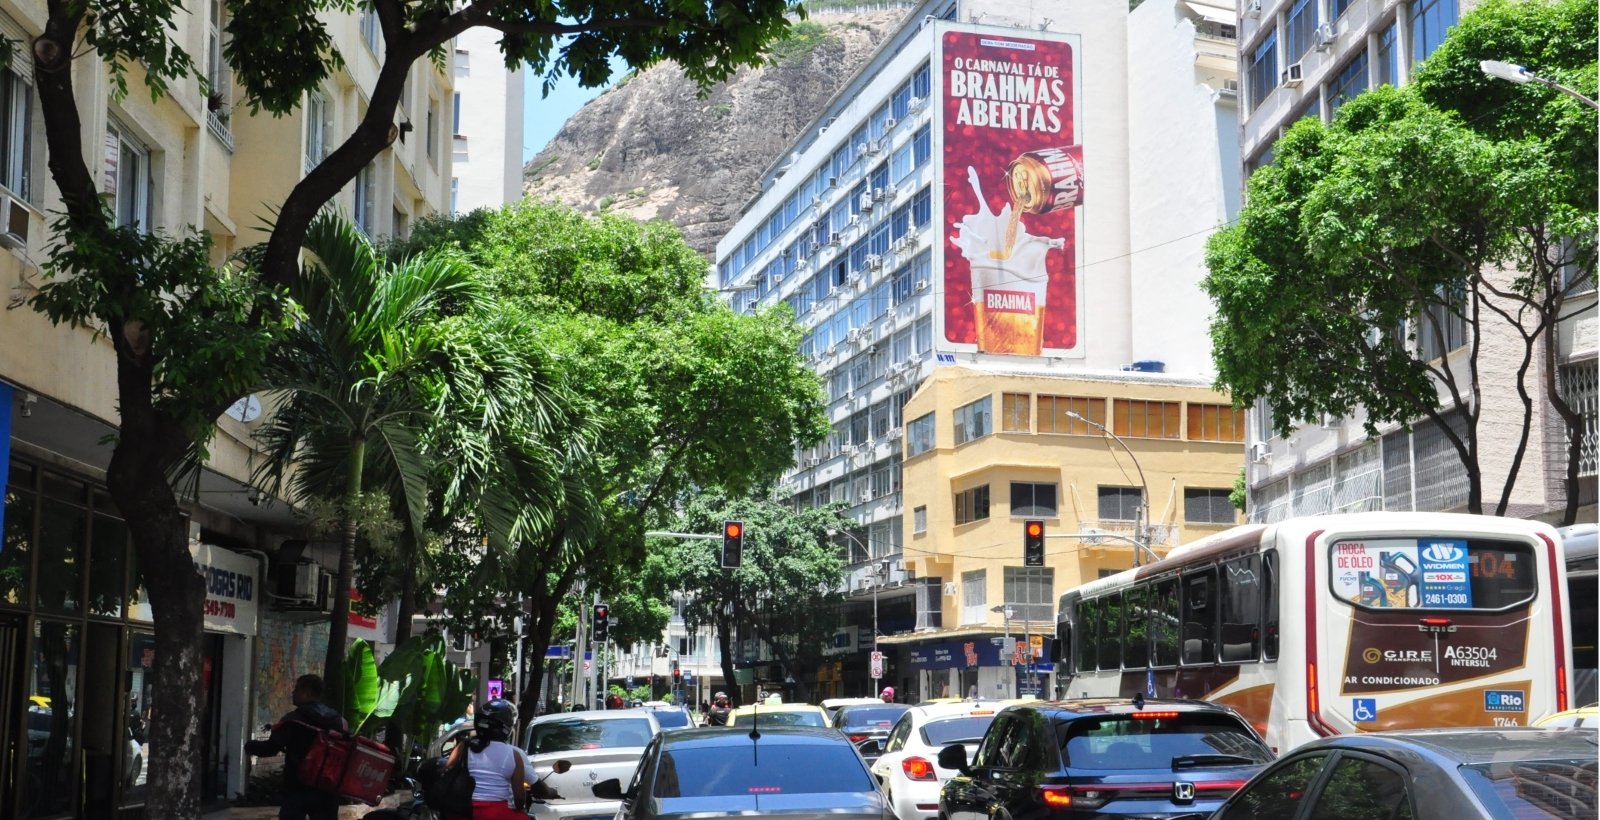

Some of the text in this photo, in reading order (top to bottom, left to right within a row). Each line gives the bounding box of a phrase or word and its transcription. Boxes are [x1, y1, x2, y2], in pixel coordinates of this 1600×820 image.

[954, 57, 1059, 78] O CARNAVAL TÁ DE
[951, 70, 1065, 107] BRAHMAS
[956, 98, 1061, 133] ABERTAS
[987, 293, 1032, 311] BRAHMA
[1337, 543, 1366, 555] TROCA
[1337, 554, 1373, 569] DE ÓLEO
[236, 573, 253, 602] RIO
[1425, 593, 1468, 605] 2461-0300
[1384, 650, 1432, 659] GIRE
[1444, 645, 1498, 660] A63504
[1451, 658, 1491, 668] INTERSUL
[1344, 676, 1440, 685] AR CONDICIONADO
[1500, 694, 1522, 706] Rio
